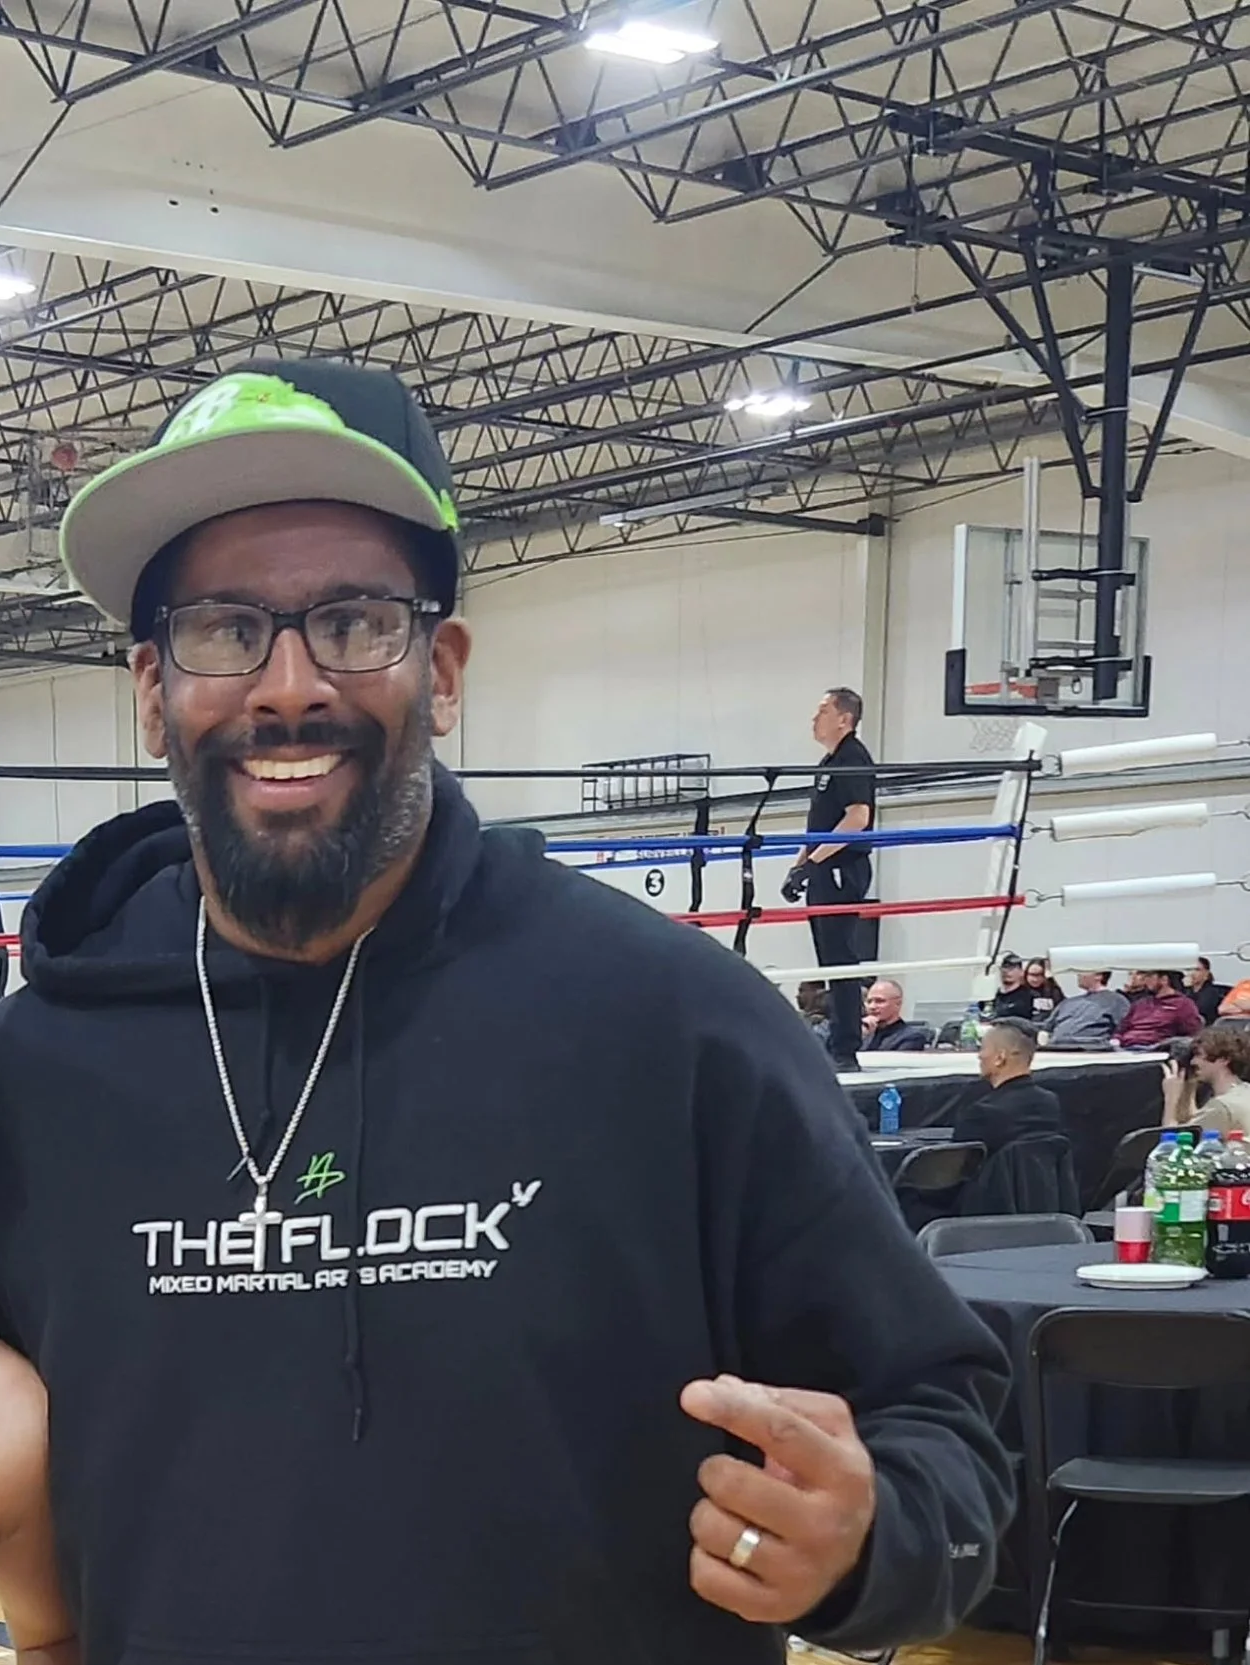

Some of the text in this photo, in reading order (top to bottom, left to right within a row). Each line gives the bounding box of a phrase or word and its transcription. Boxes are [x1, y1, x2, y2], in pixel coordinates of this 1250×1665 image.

[647, 872, 662, 894] 3
[132, 1202, 511, 1267] THE FLOCK
[149, 1275, 213, 1295] MIXED
[216, 1271, 312, 1294] MARTIAL
[379, 1259, 498, 1284] ACADEMY
